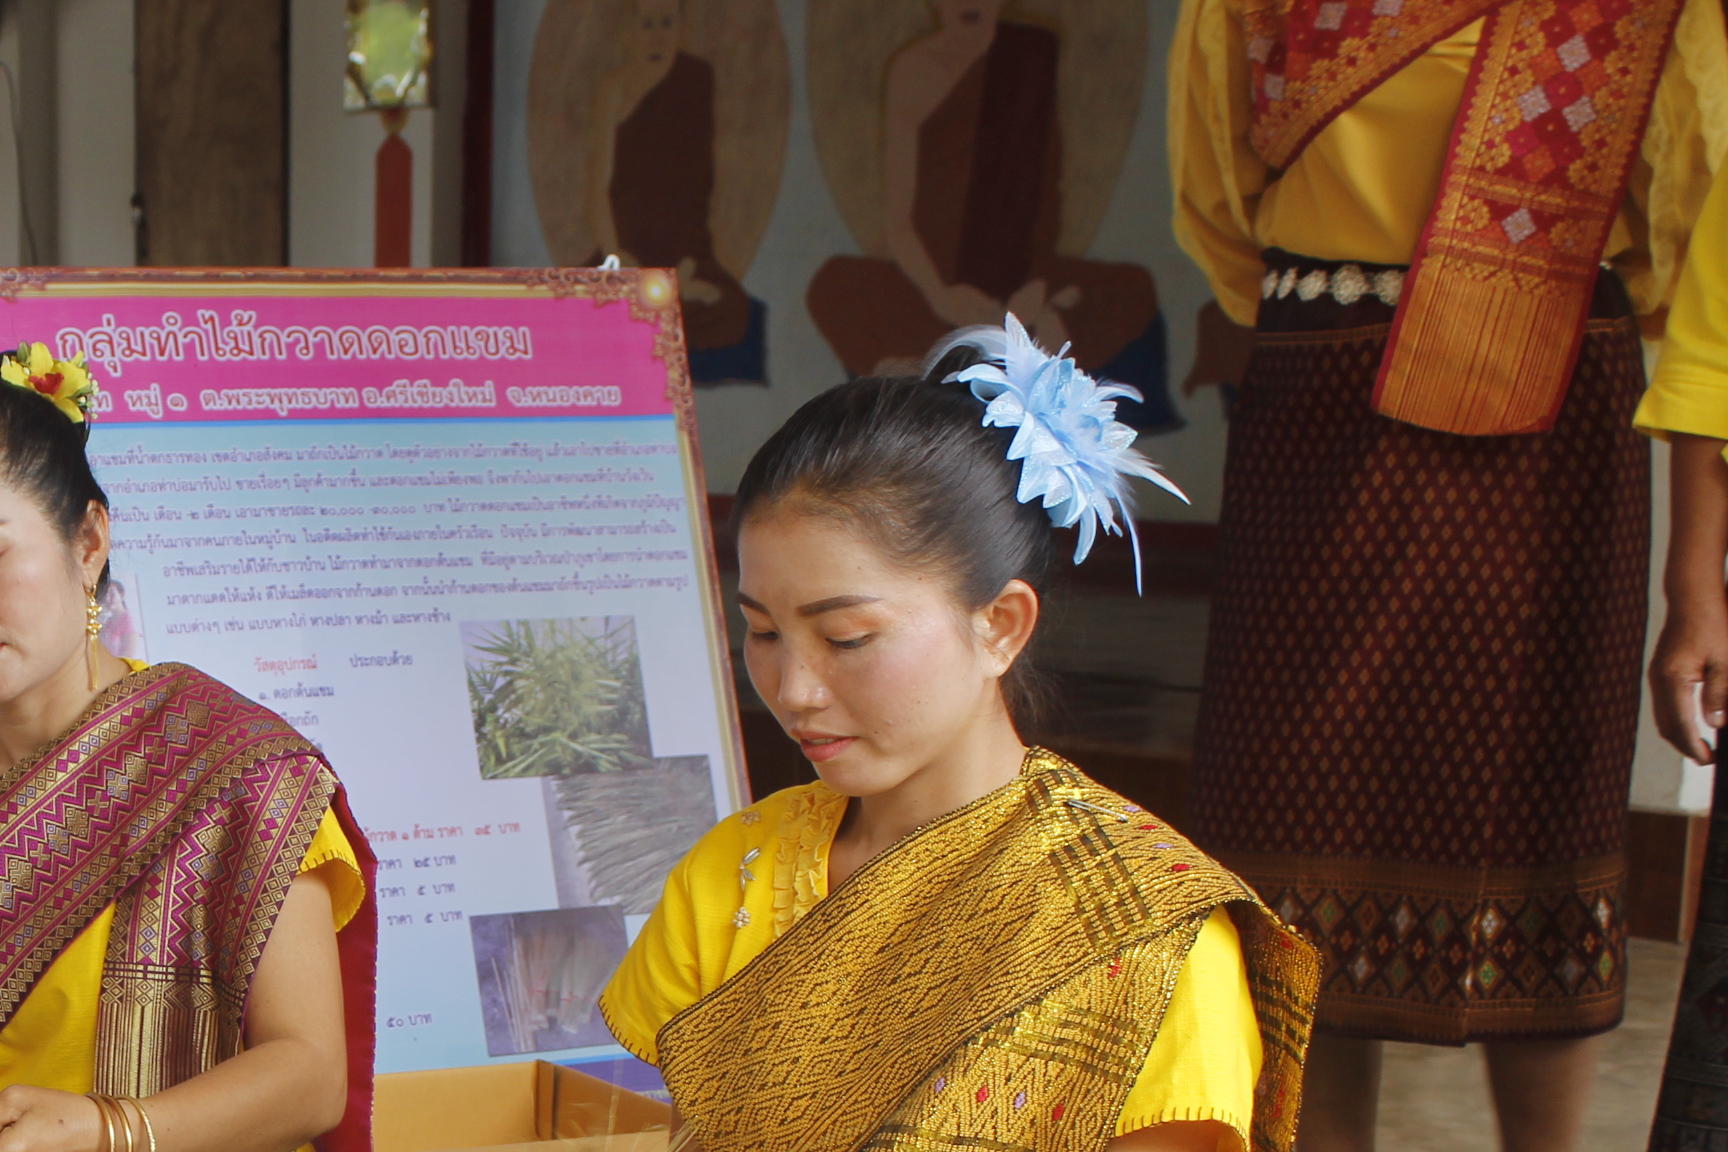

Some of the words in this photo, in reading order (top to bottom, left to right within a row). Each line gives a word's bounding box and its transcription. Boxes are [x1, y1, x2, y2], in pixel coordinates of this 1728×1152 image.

[56, 309, 532, 377] กลุ่มทำไม้กวาดดอกแขม
[124, 384, 162, 418] หมู่
[167, 391, 189, 411] ๑
[201, 386, 358, 417] ต.พระพุทธบาท
[362, 378, 497, 408] อ.ศรีเชียงใหม่
[506, 384, 622, 407] จ.หนองคาย
[498, 822, 521, 835] บาท
[434, 853, 457, 868] บาท
[379, 884, 406, 899] ราคา
[433, 882, 456, 895] บาท
[386, 912, 413, 927] ราคา
[440, 909, 463, 923] บาท
[408, 1012, 432, 1027] บาท
